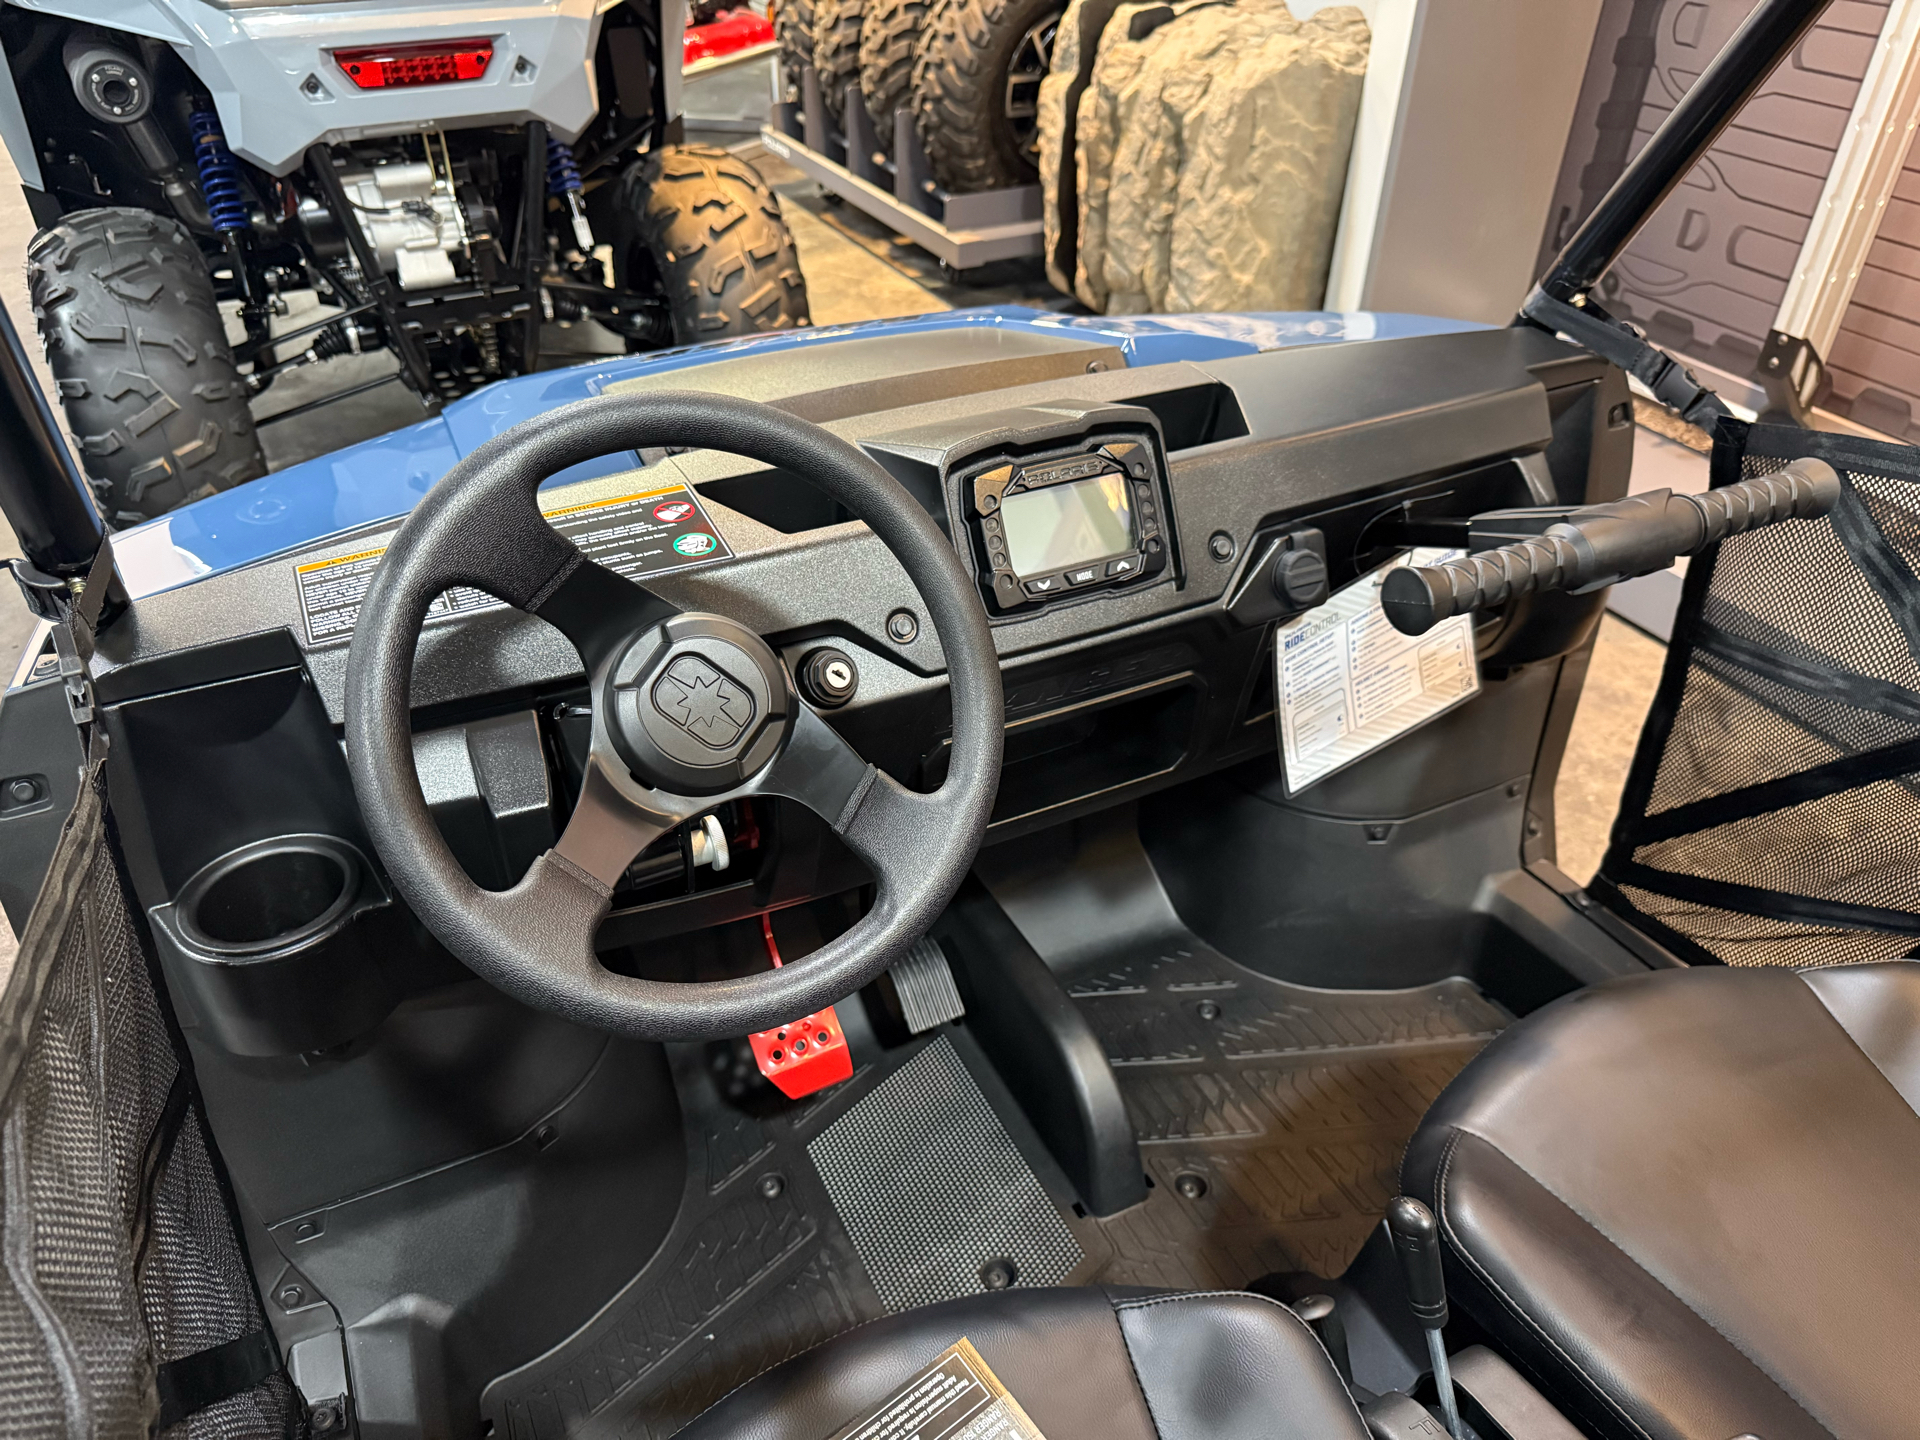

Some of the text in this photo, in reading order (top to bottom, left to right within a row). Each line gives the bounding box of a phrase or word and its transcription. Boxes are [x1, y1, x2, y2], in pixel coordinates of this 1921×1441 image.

[1026, 461, 1100, 486] POLARIS
[340, 548, 386, 562] WARNI
[1076, 570, 1094, 582] MODE
[918, 1372, 946, 1395] Operation
[912, 1384, 945, 1411] supervision
[926, 1396, 947, 1414] manual
[944, 1389, 956, 1400] this
[887, 1394, 916, 1418] prohibited
[880, 1415, 890, 1425] for
[886, 1411, 911, 1432] required
[902, 1409, 929, 1432] carefully.
[973, 1409, 1003, 1434] RANGER
[979, 1418, 1010, 1441] RANGER
[859, 1421, 882, 1441] children
[879, 1428, 889, 1438] for
